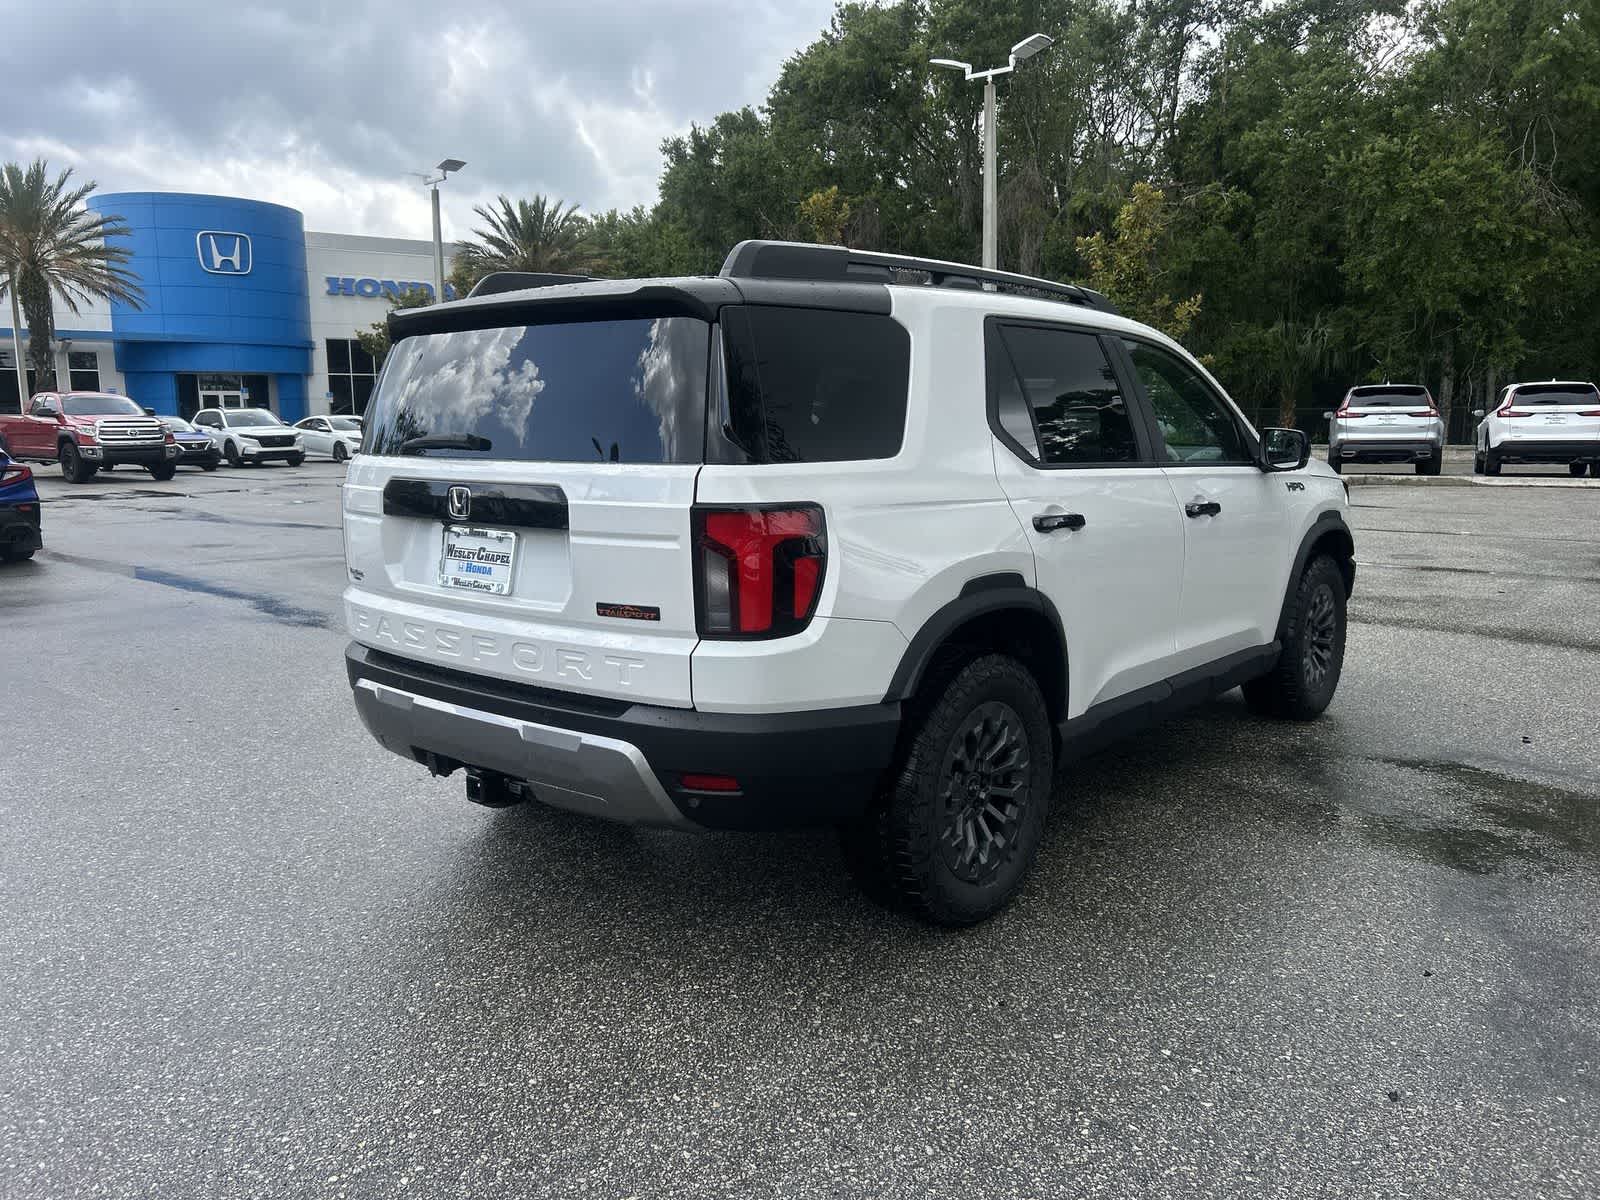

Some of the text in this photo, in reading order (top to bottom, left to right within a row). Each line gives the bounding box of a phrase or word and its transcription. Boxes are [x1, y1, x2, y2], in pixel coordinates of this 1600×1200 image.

[447, 544, 510, 564] WESLEY CHAPEL
[465, 561, 492, 575] HONDA
[598, 606, 657, 619] TRAILSPORT
[353, 605, 645, 686] PASSPORT
